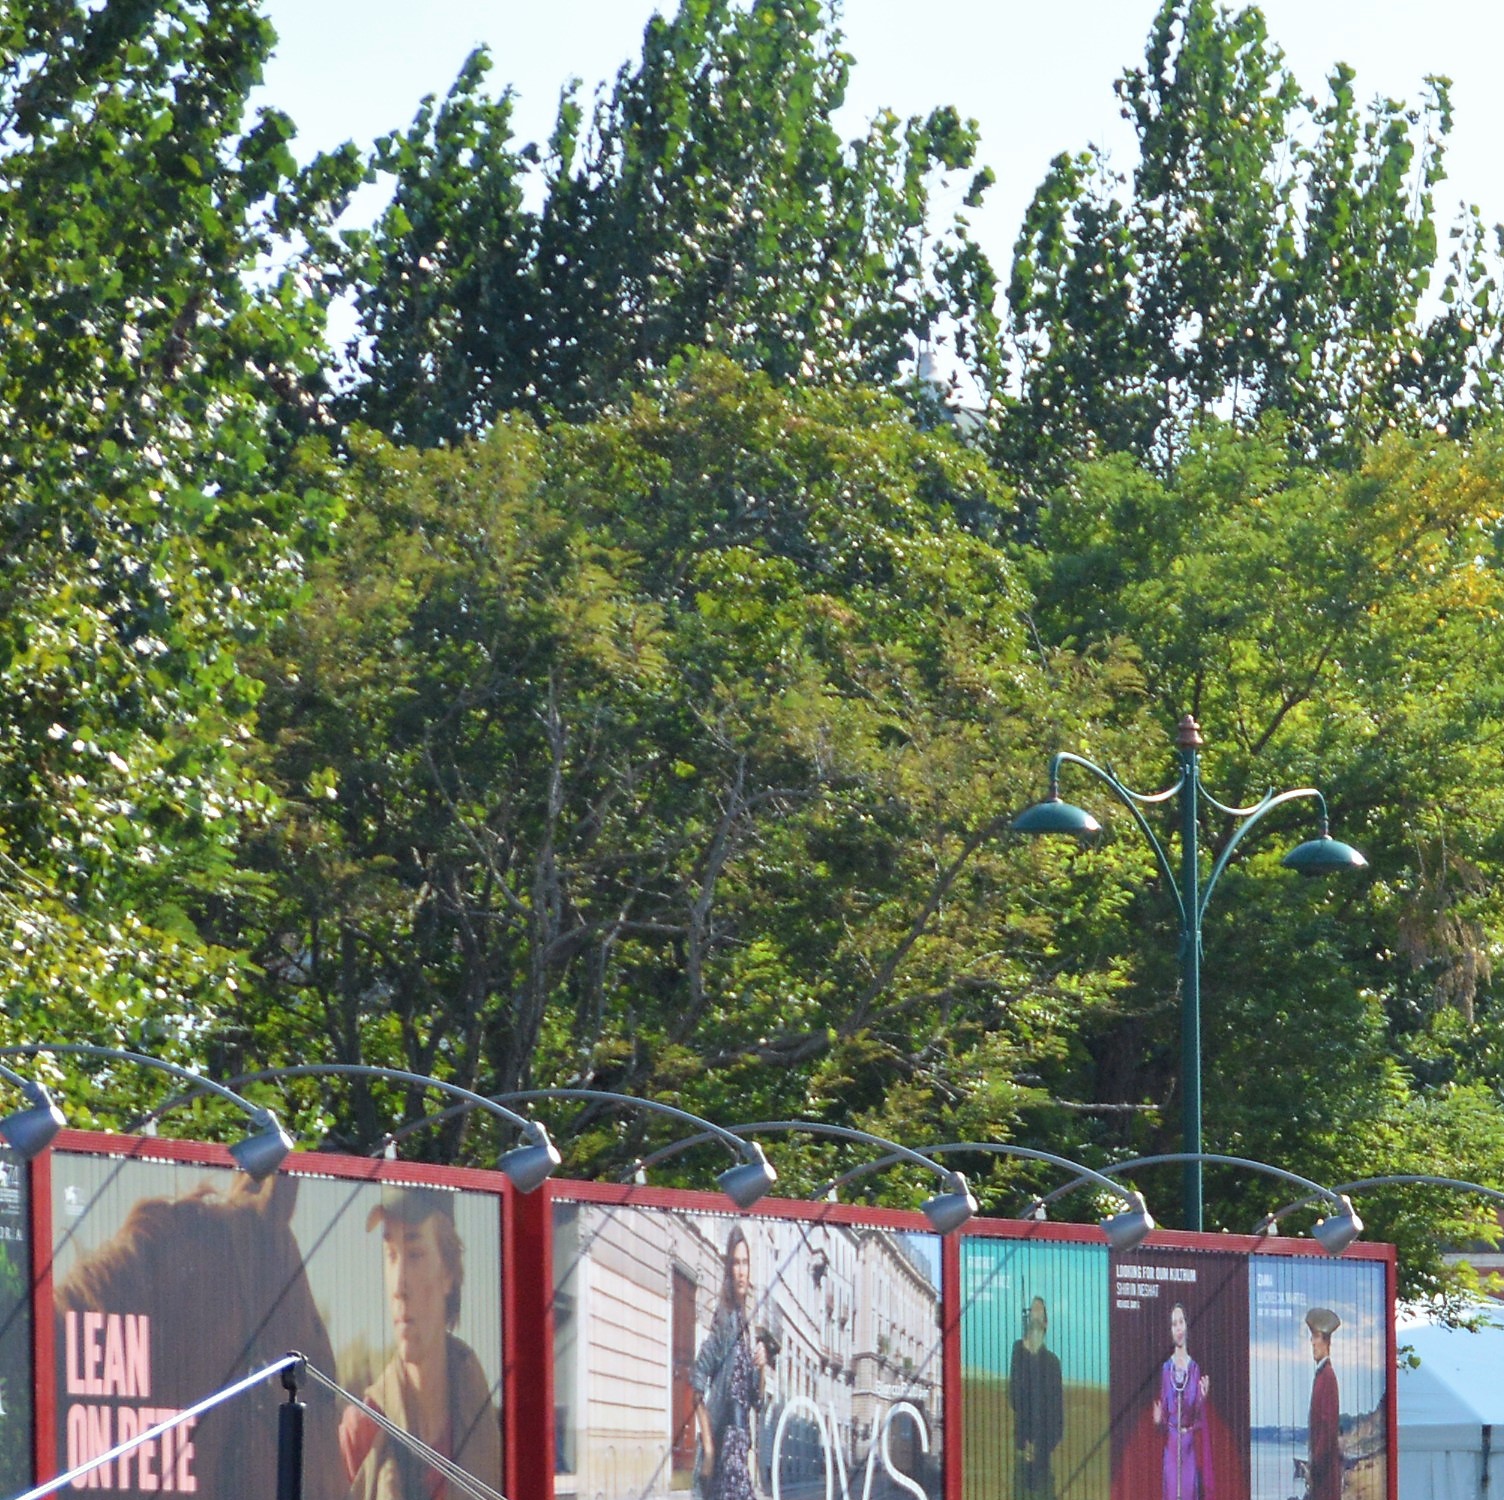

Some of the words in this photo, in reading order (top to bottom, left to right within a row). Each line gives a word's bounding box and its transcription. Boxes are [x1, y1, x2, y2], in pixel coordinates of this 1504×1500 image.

[1142, 1265, 1155, 1279] FOR
[65, 1311, 150, 1397] LEAN
[67, 1403, 112, 1490] ON
[117, 1405, 198, 1492] PETE
